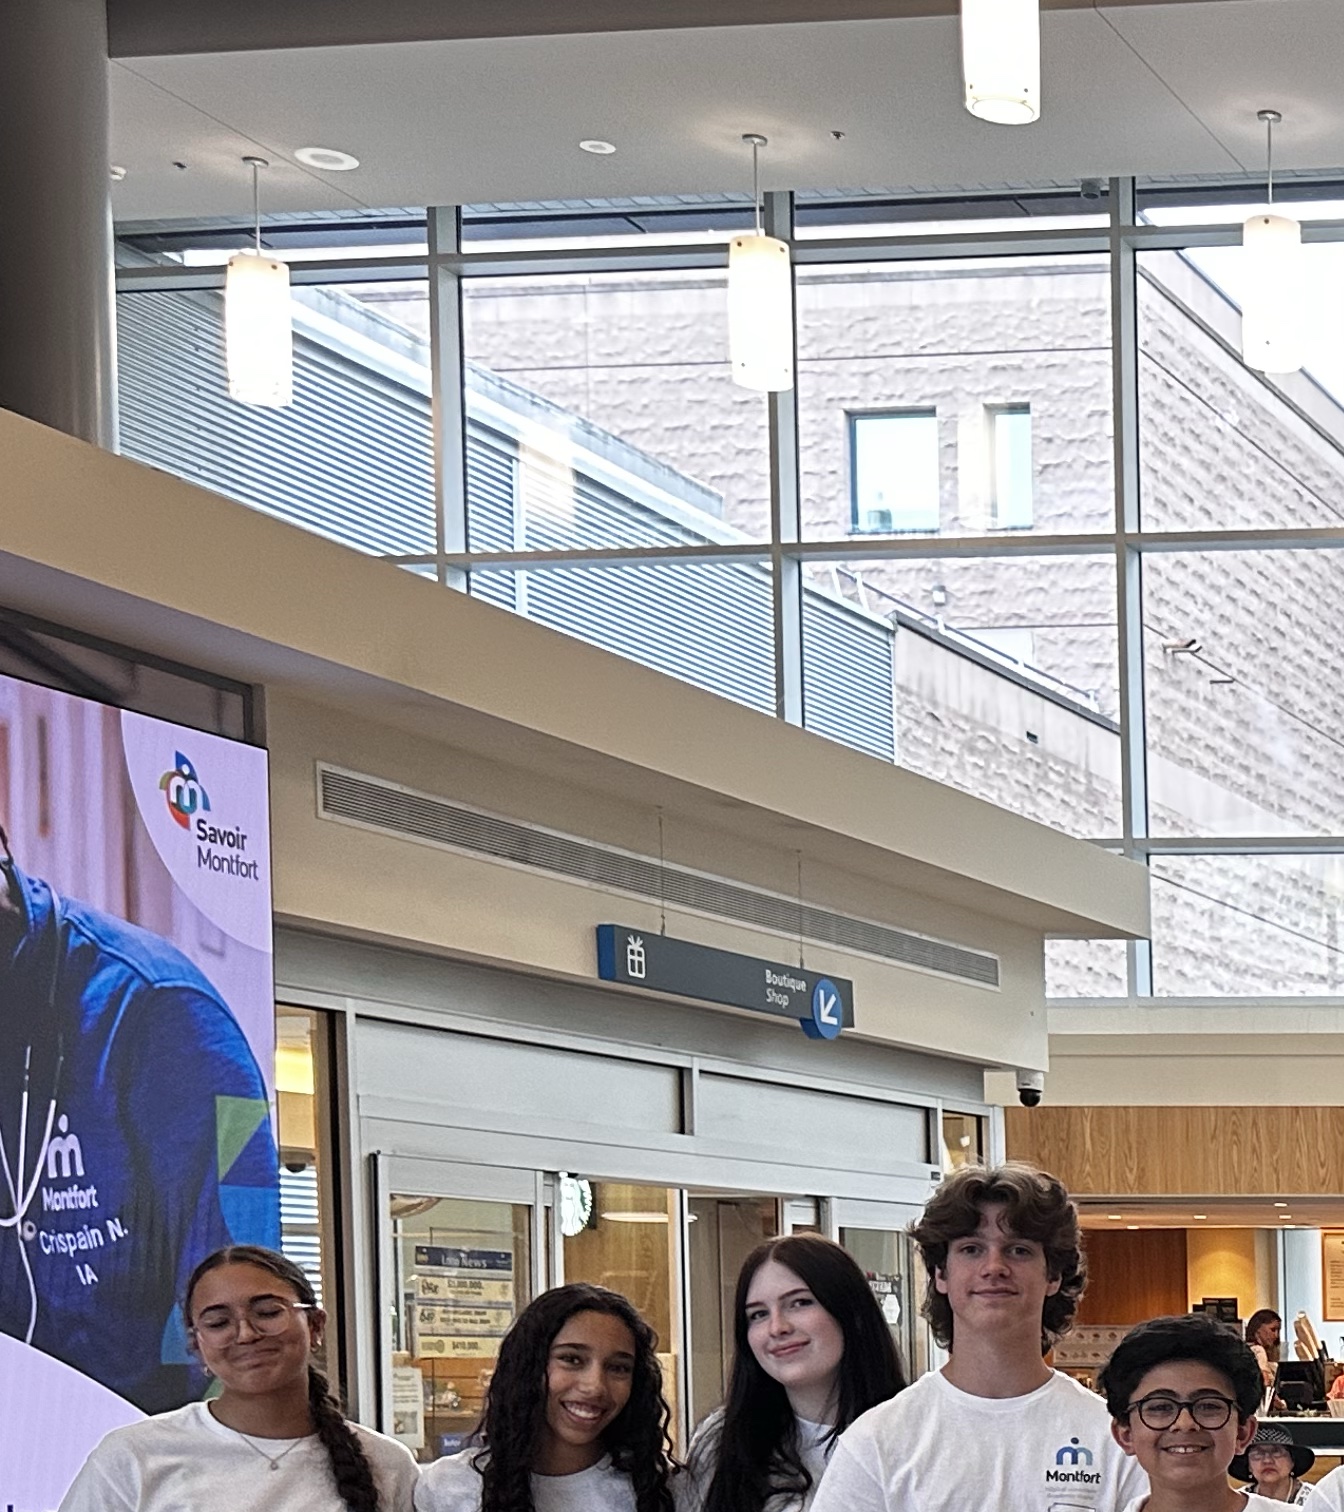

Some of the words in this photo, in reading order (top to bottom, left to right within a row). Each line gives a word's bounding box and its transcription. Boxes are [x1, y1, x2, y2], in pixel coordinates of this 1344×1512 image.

[196, 818, 248, 851] Savoir
[196, 844, 259, 881] Montfort
[765, 968, 807, 993] Boutique
[766, 987, 790, 1008] Shop
[42, 1184, 99, 1211] Montfort
[39, 1224, 105, 1258] Crispain
[106, 1217, 129, 1242] N.
[76, 1263, 99, 1286] IA
[1045, 1469, 1101, 1485] Montfort
